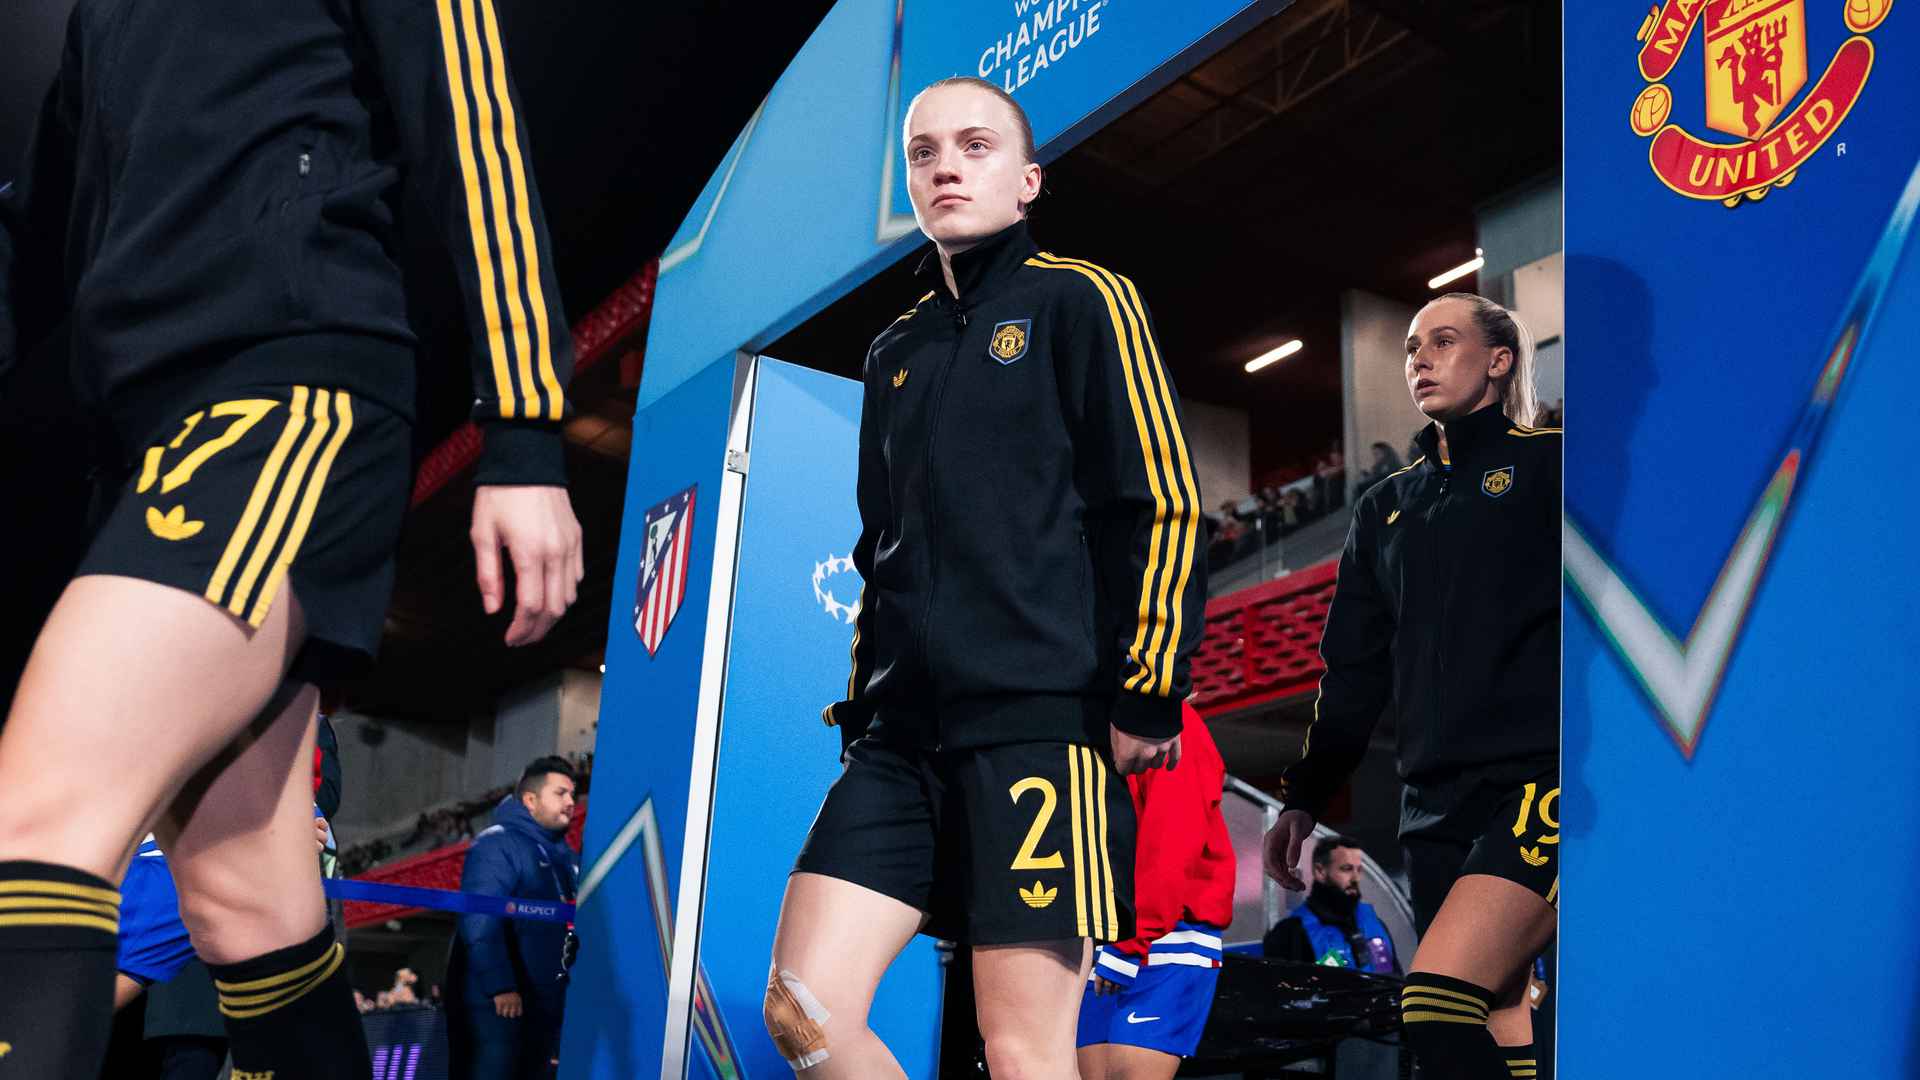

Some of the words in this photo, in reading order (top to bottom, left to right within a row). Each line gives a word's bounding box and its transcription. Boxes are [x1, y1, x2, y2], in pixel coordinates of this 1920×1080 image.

[1004, 1, 1101, 95] LEAGUE
[1689, 98, 1834, 187] UNITED
[136, 398, 281, 494] 17
[1009, 776, 1065, 870] 2
[518, 904, 557, 916] RESPECT
